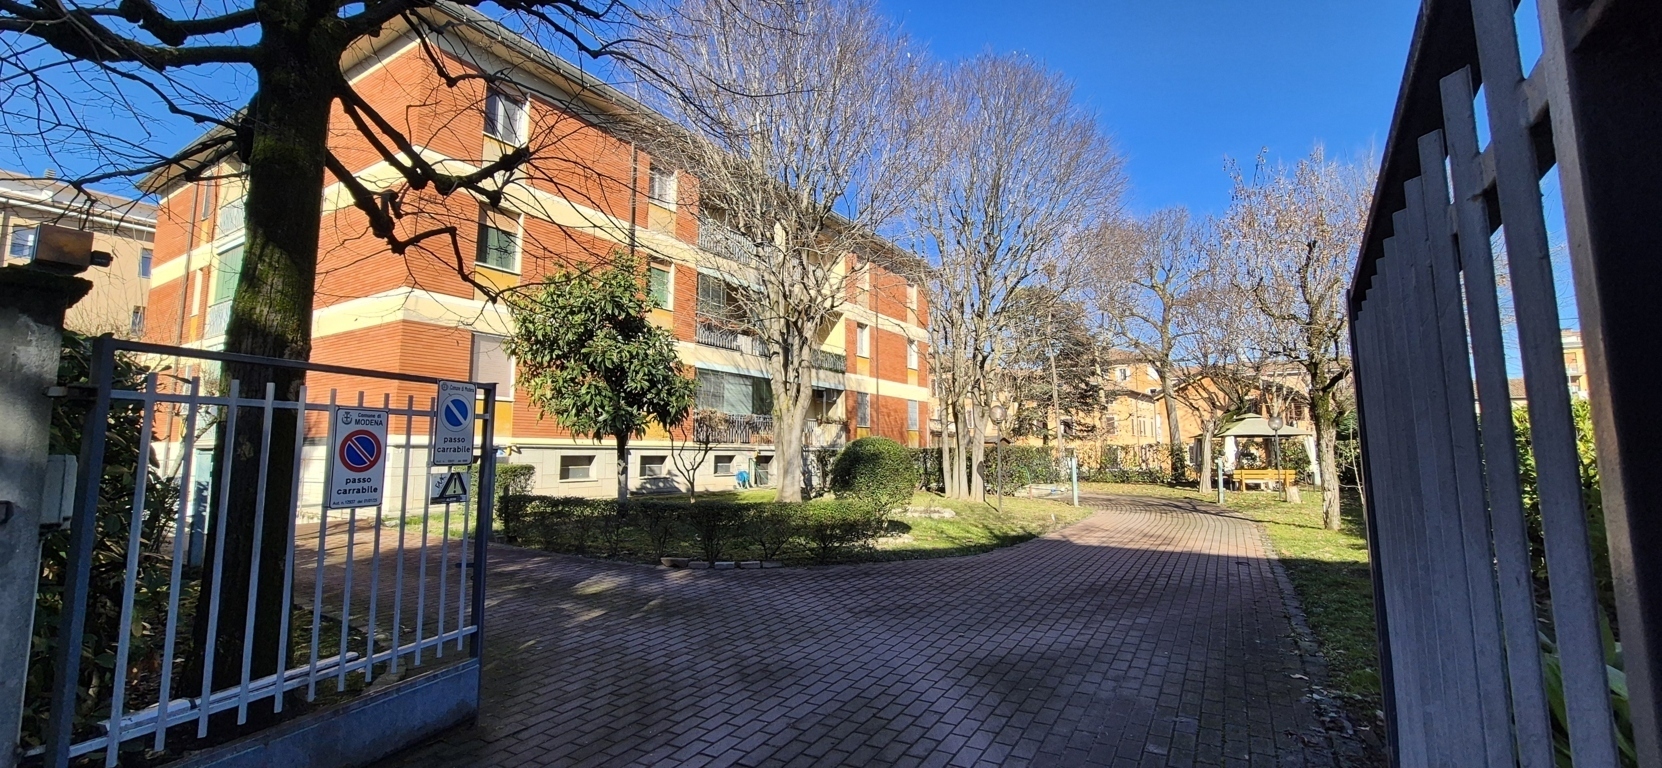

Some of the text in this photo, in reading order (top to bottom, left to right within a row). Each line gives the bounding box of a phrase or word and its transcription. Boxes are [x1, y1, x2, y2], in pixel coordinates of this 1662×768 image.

[437, 445, 470, 453] carrabile
[345, 477, 372, 485] passo
[337, 486, 378, 495] carrabile
